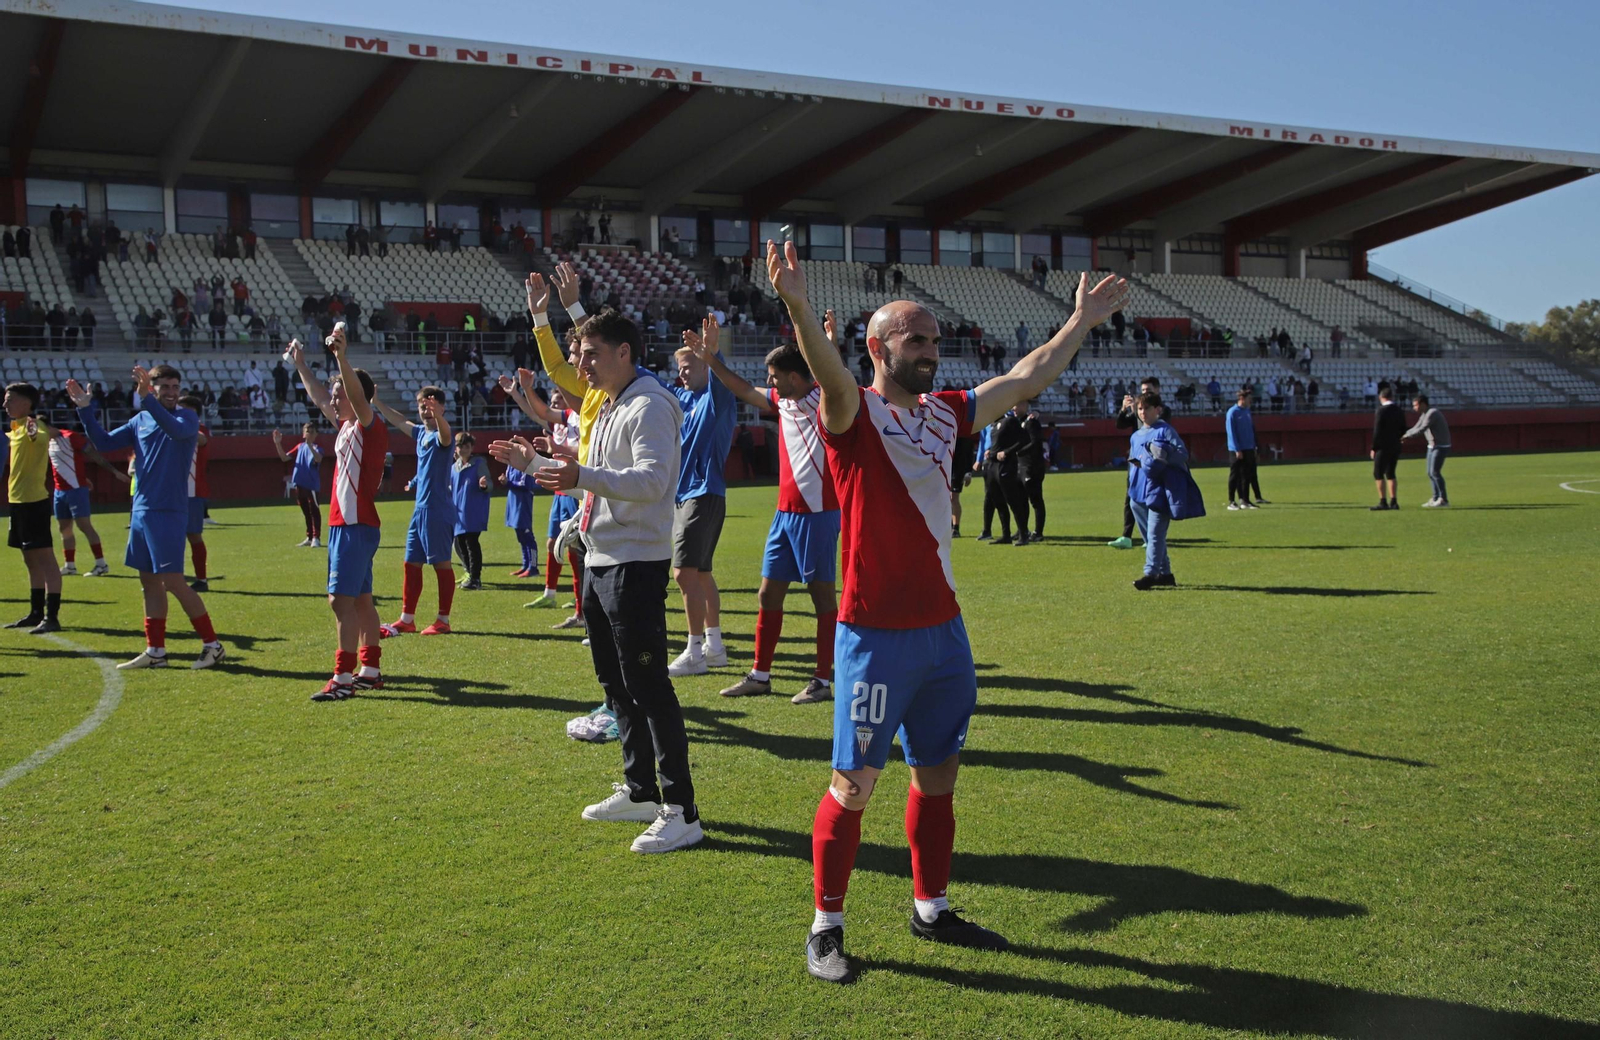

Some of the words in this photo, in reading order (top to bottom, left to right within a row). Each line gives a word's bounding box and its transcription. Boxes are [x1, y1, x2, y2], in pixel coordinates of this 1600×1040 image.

[344, 36, 712, 84] MUNICIPAL
[928, 96, 1076, 119] NUEVO
[1229, 125, 1399, 150] MIRADOR
[850, 681, 888, 724] 20
